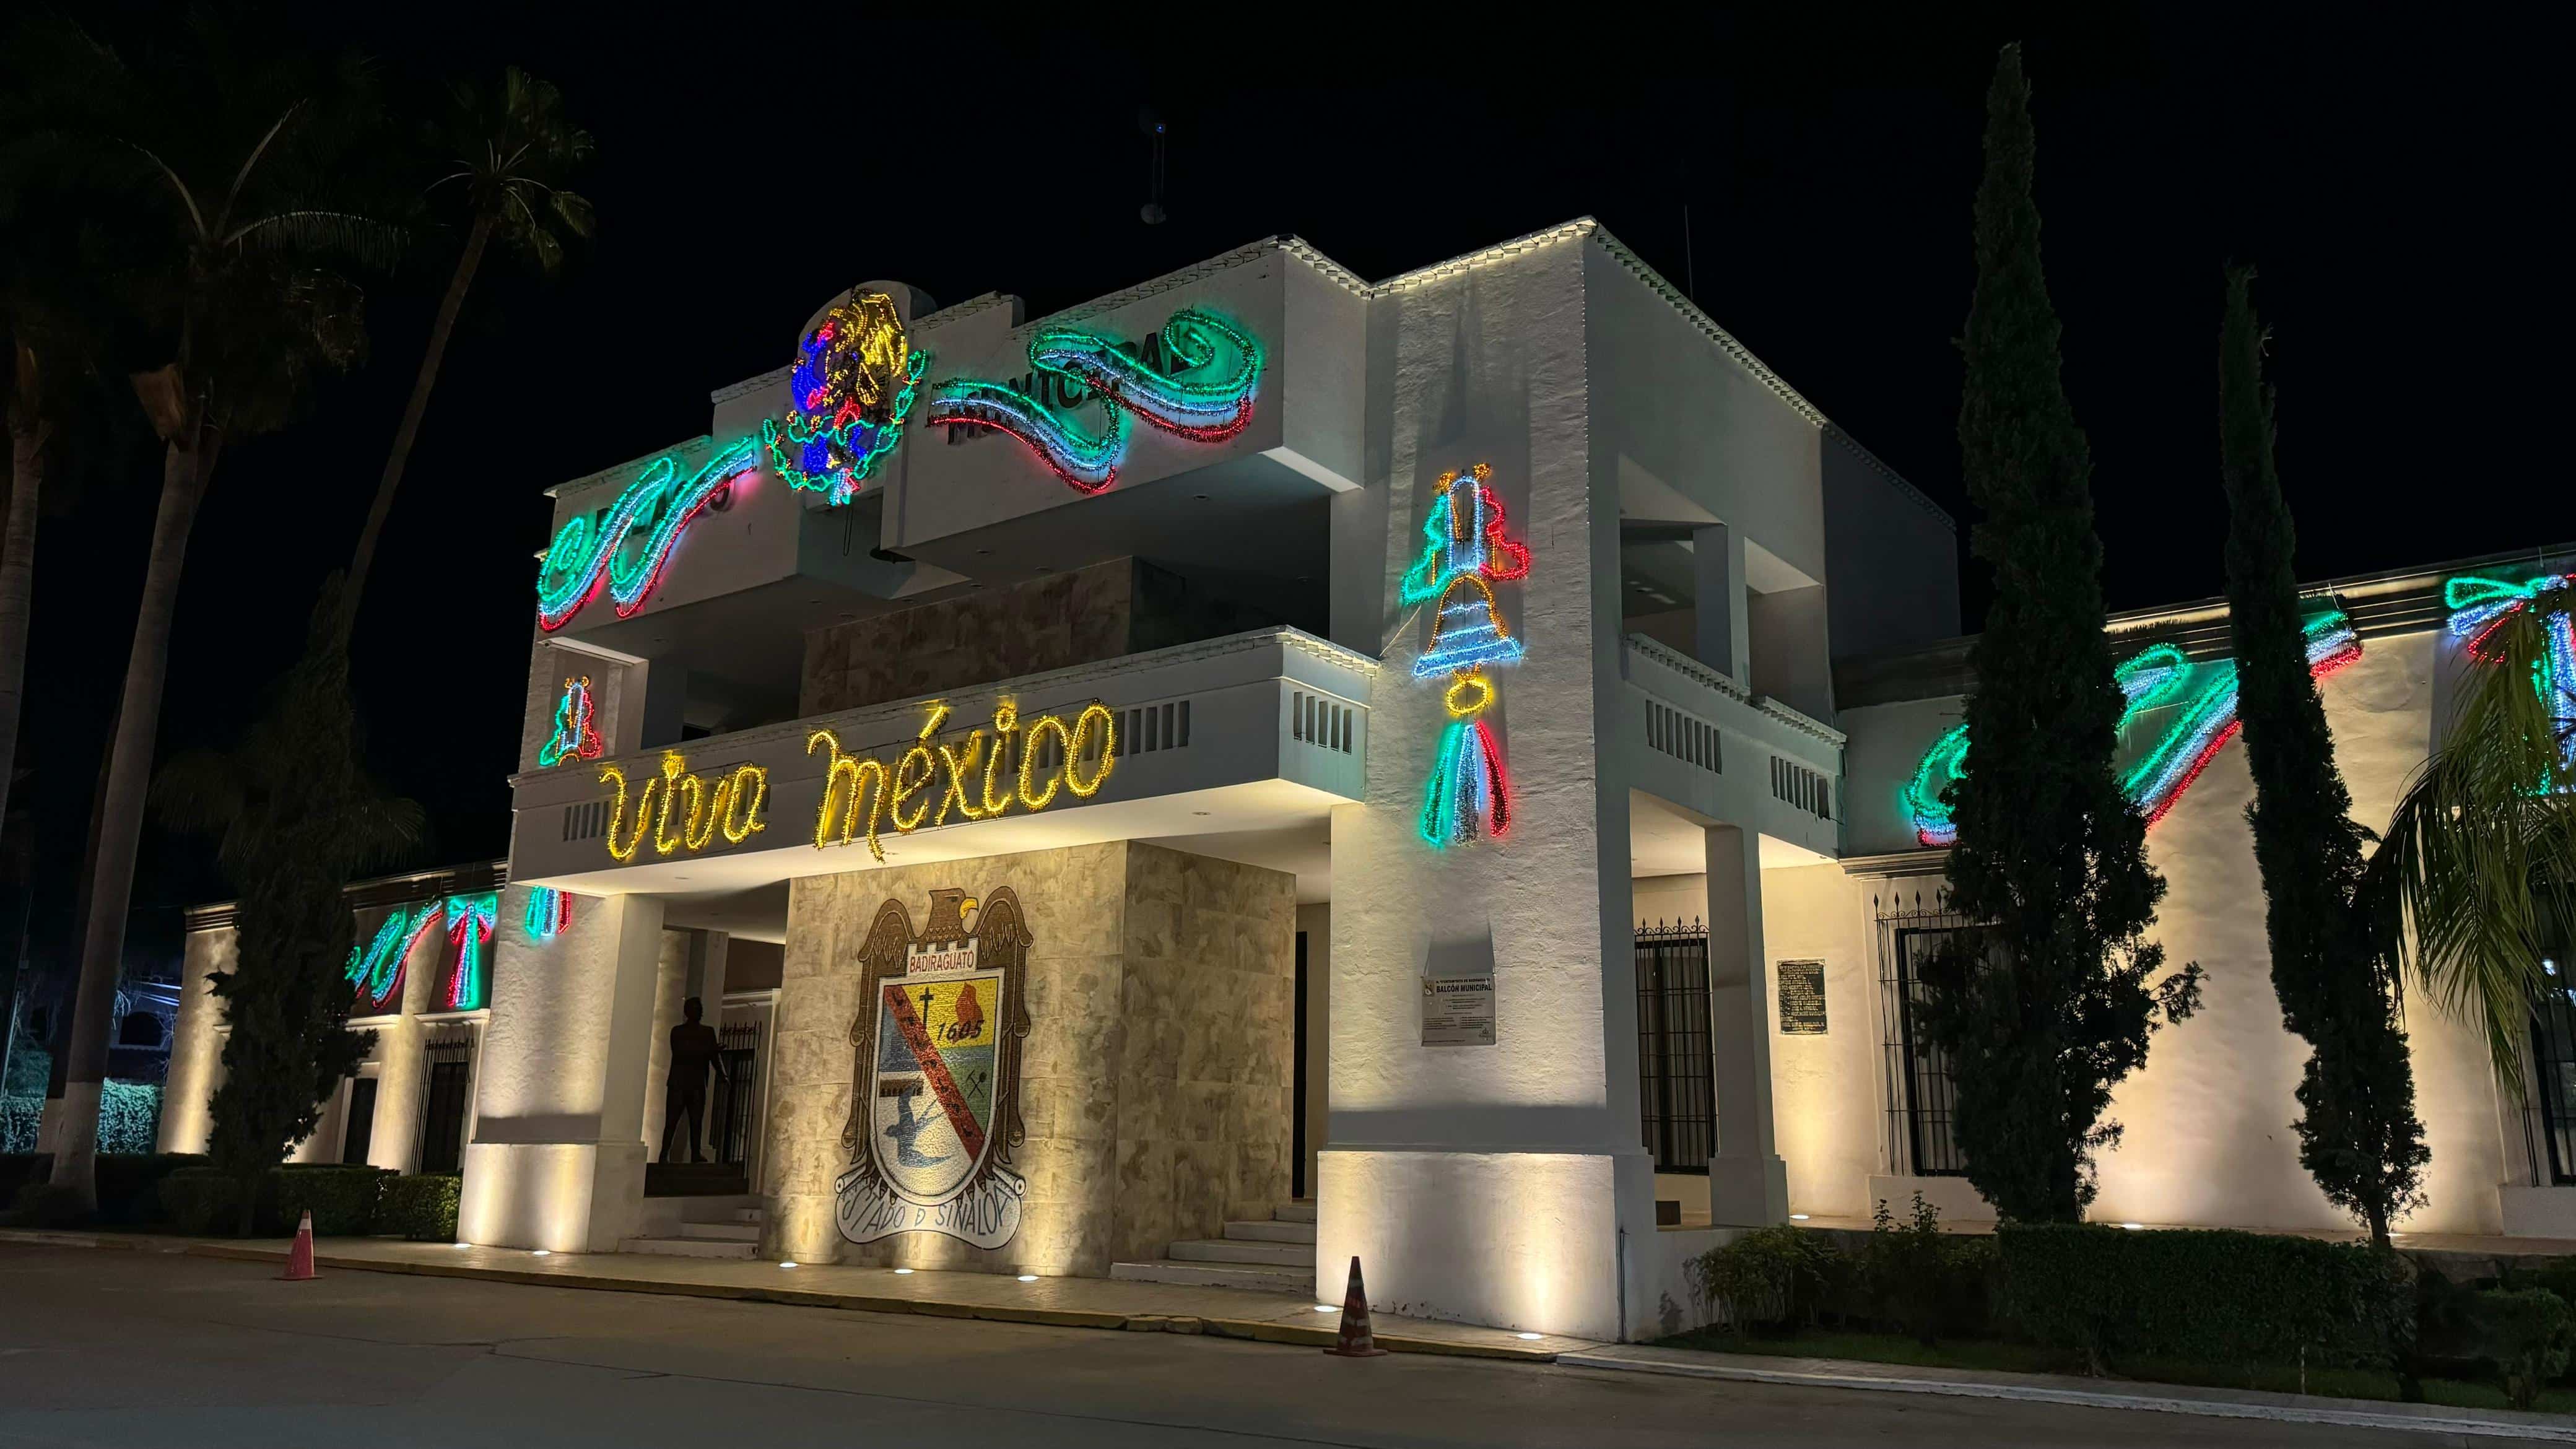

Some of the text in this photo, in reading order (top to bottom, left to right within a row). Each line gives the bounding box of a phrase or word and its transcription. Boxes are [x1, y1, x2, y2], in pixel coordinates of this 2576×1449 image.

[910, 951, 975, 973] BADIRAGUATO
[1436, 983, 1492, 993] BALCÓN MUNICIPAL
[938, 1019, 985, 1043] 1605
[935, 1184, 1014, 1236] SINALOA
